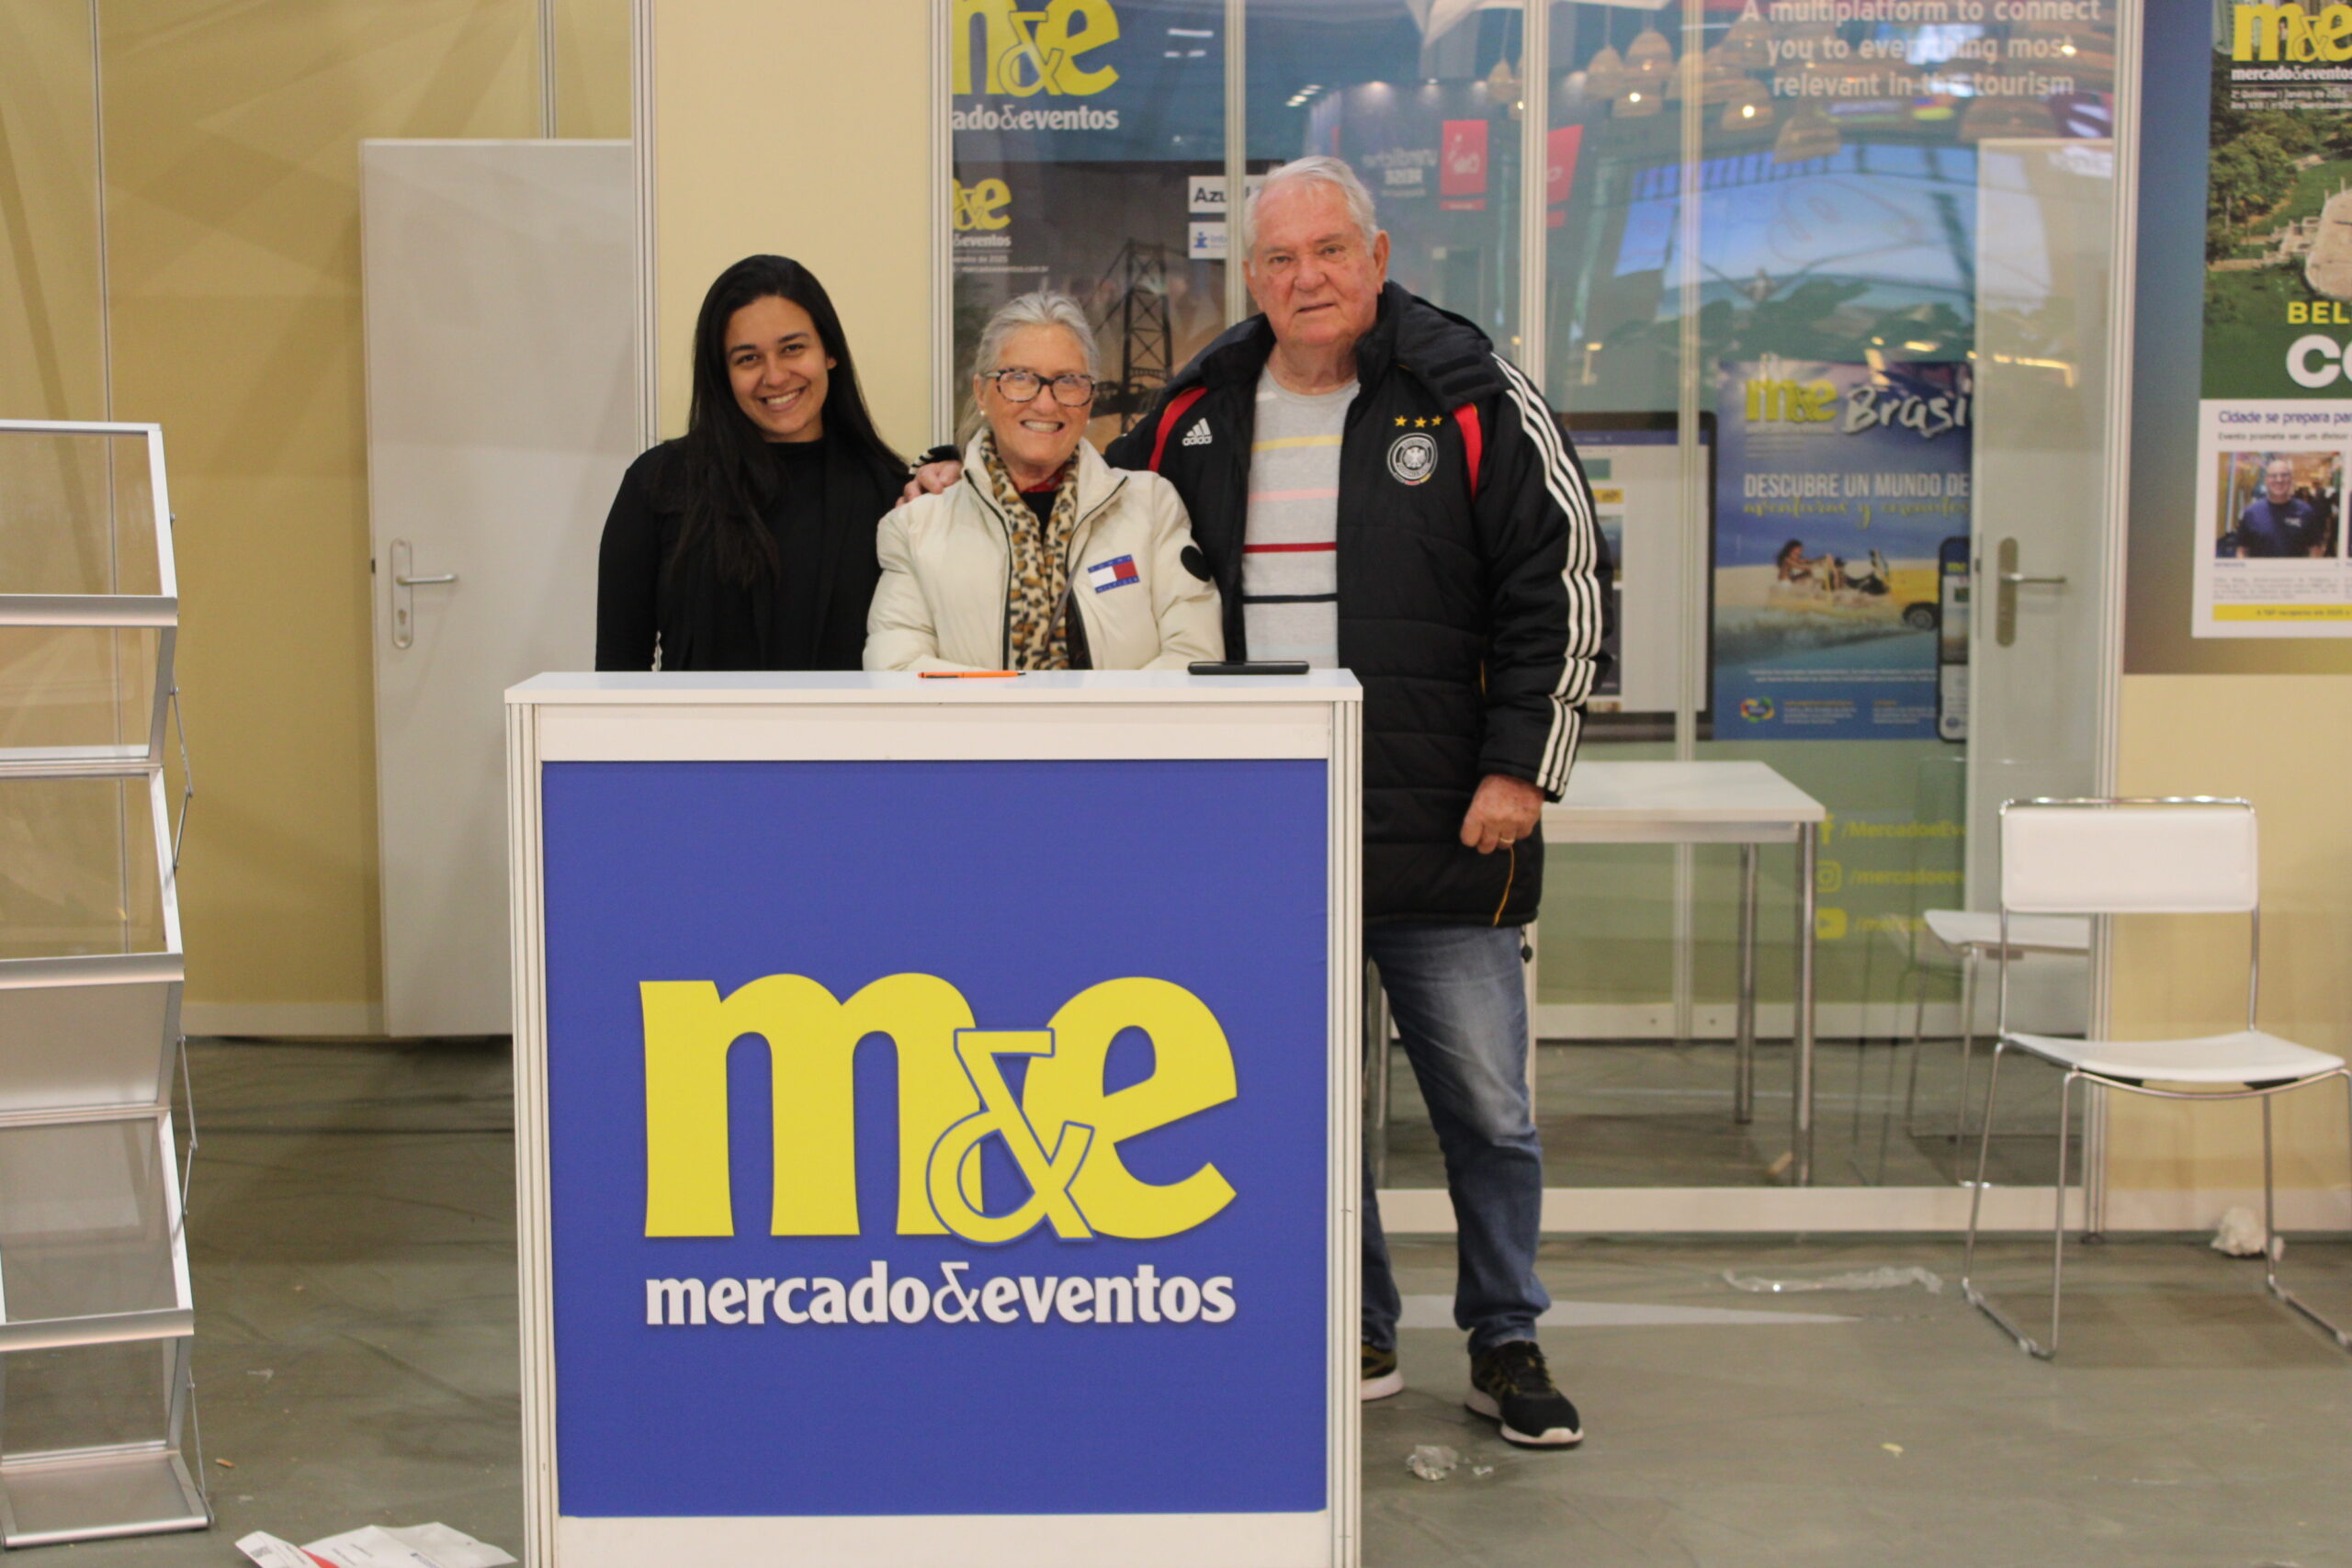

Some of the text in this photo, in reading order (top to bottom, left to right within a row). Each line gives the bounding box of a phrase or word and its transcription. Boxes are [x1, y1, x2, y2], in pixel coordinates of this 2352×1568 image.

[1742, 0, 2101, 27] A multiplatform to connect
[1766, 39, 1814, 65] you
[1823, 38, 1849, 59] to
[1773, 72, 1879, 96] relevant
[1889, 72, 1913, 95] in
[1974, 72, 2075, 96] tourism
[2219, 410, 2261, 423] Cidade
[2266, 413, 2279, 423] se
[2282, 412, 2330, 426] prepara
[1182, 434, 1213, 446] adidas
[1743, 473, 1971, 498] DESCUBRE UN MUNDO DE
[639, 972, 1238, 1244] m&e
[645, 1260, 1237, 1325] mercado&eventos
